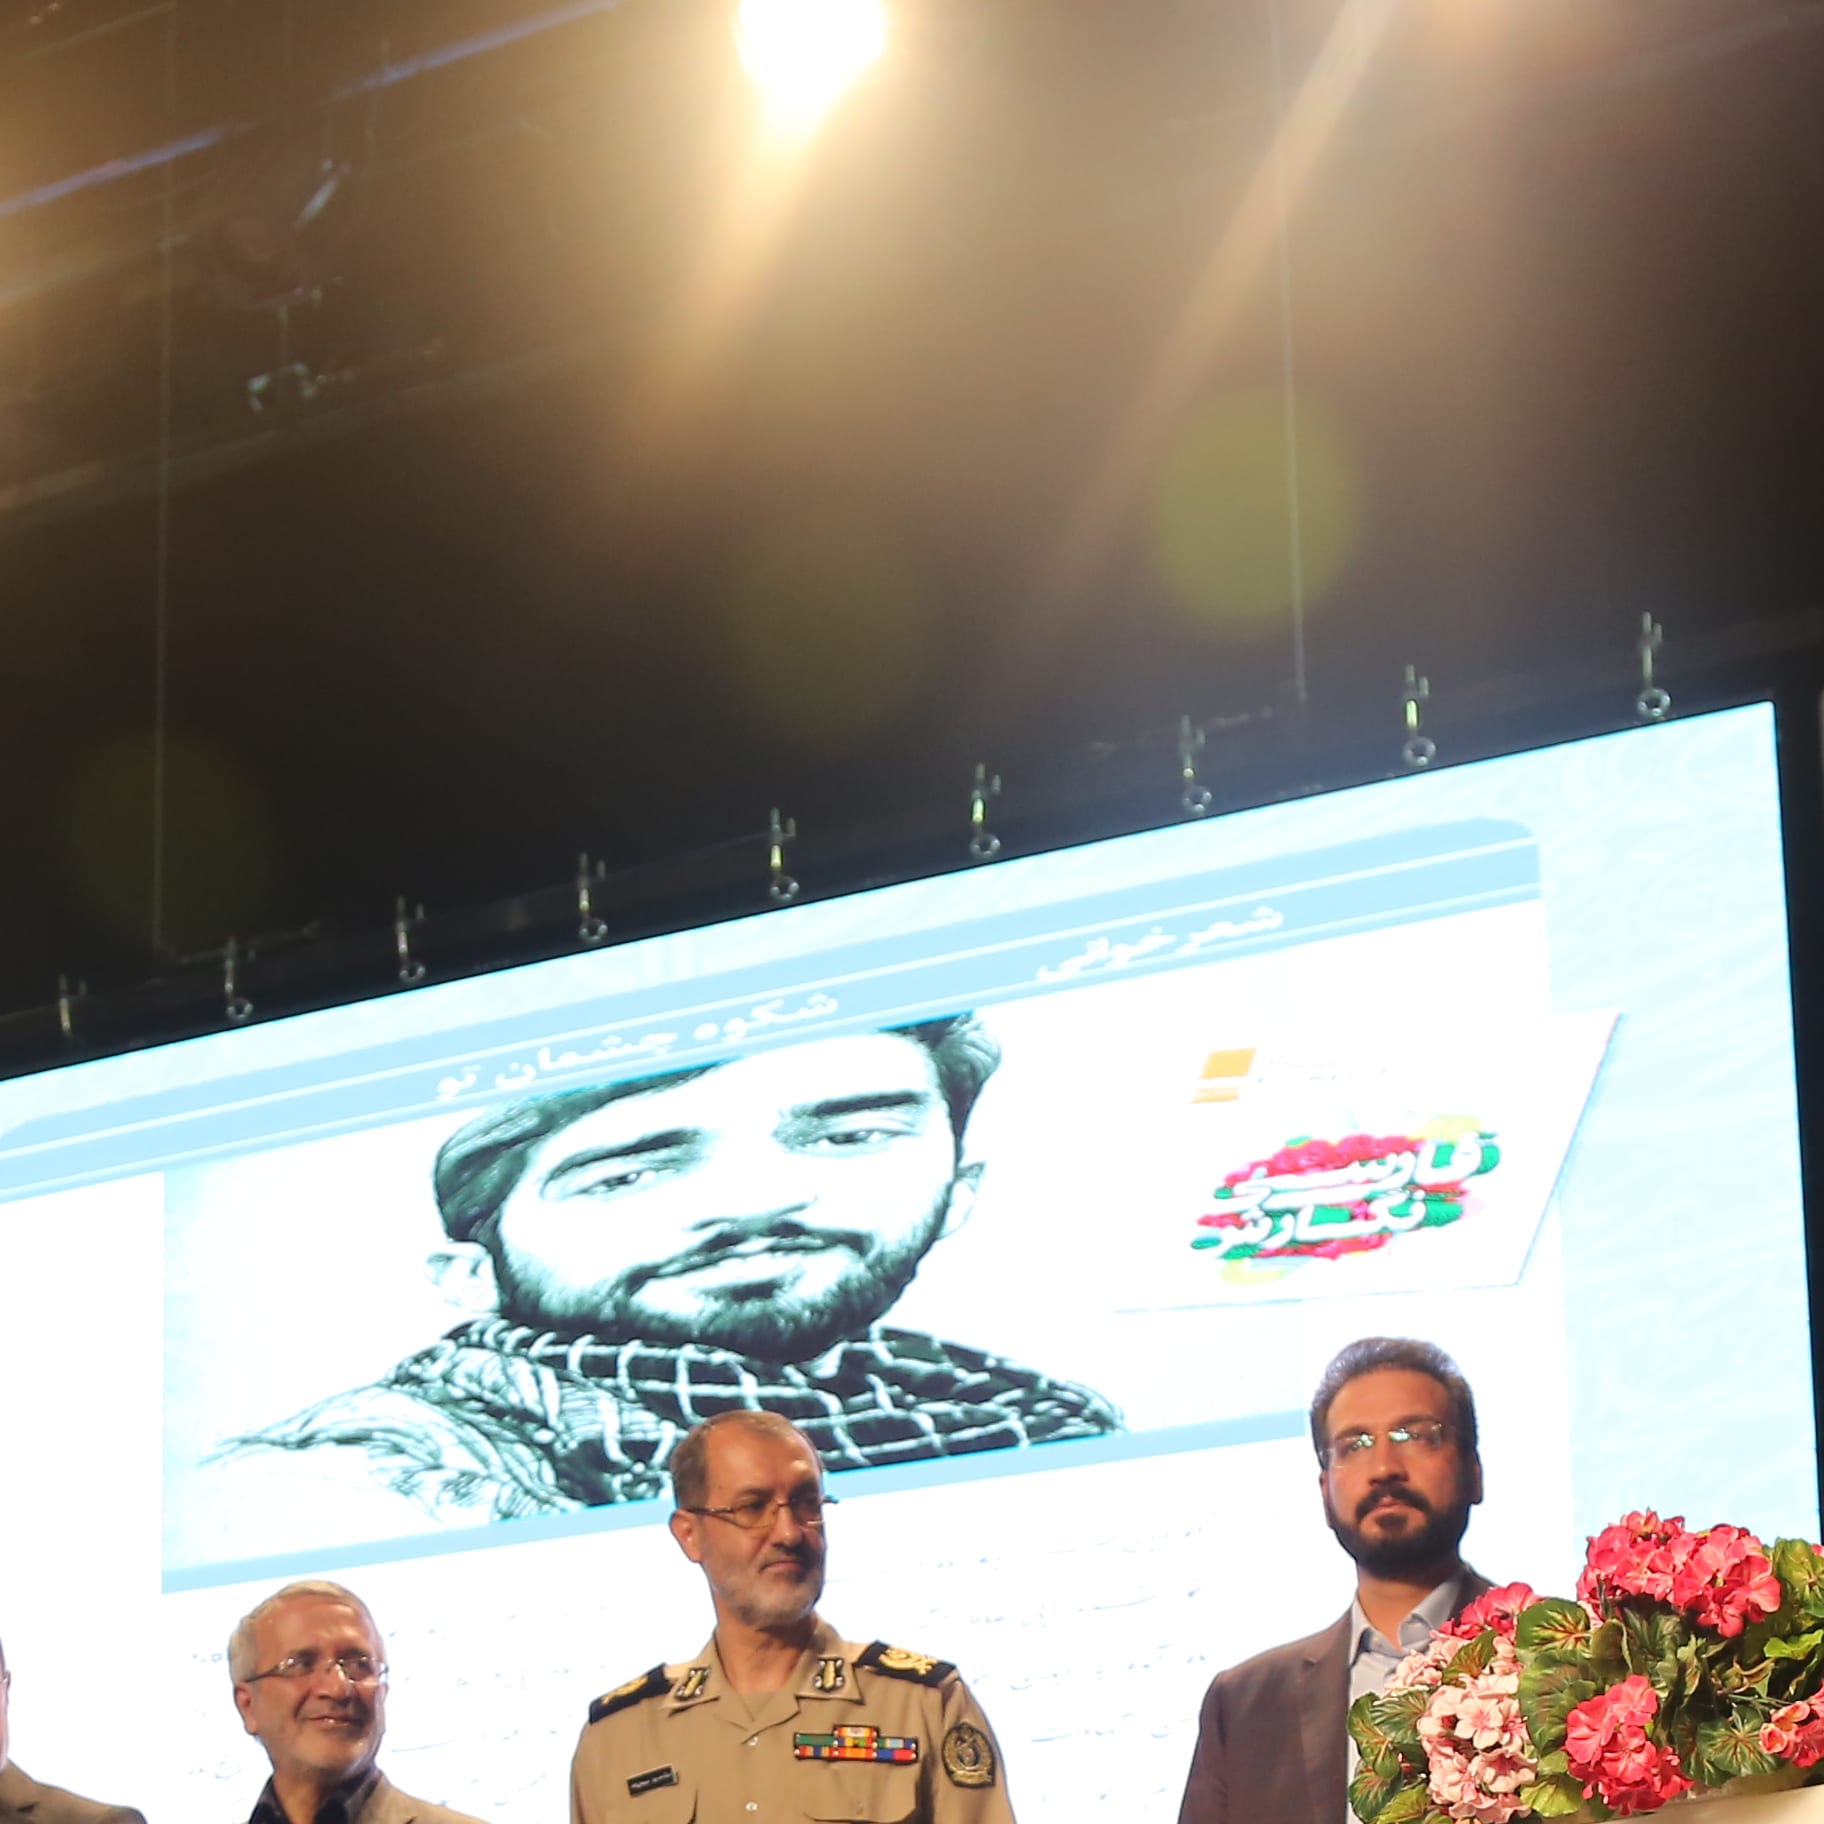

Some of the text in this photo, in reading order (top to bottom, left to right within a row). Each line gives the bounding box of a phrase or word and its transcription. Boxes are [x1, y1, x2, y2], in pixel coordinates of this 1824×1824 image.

[436, 992, 840, 1100] شکوه چشمان تو
[1196, 1131, 1499, 1214] فارسی
